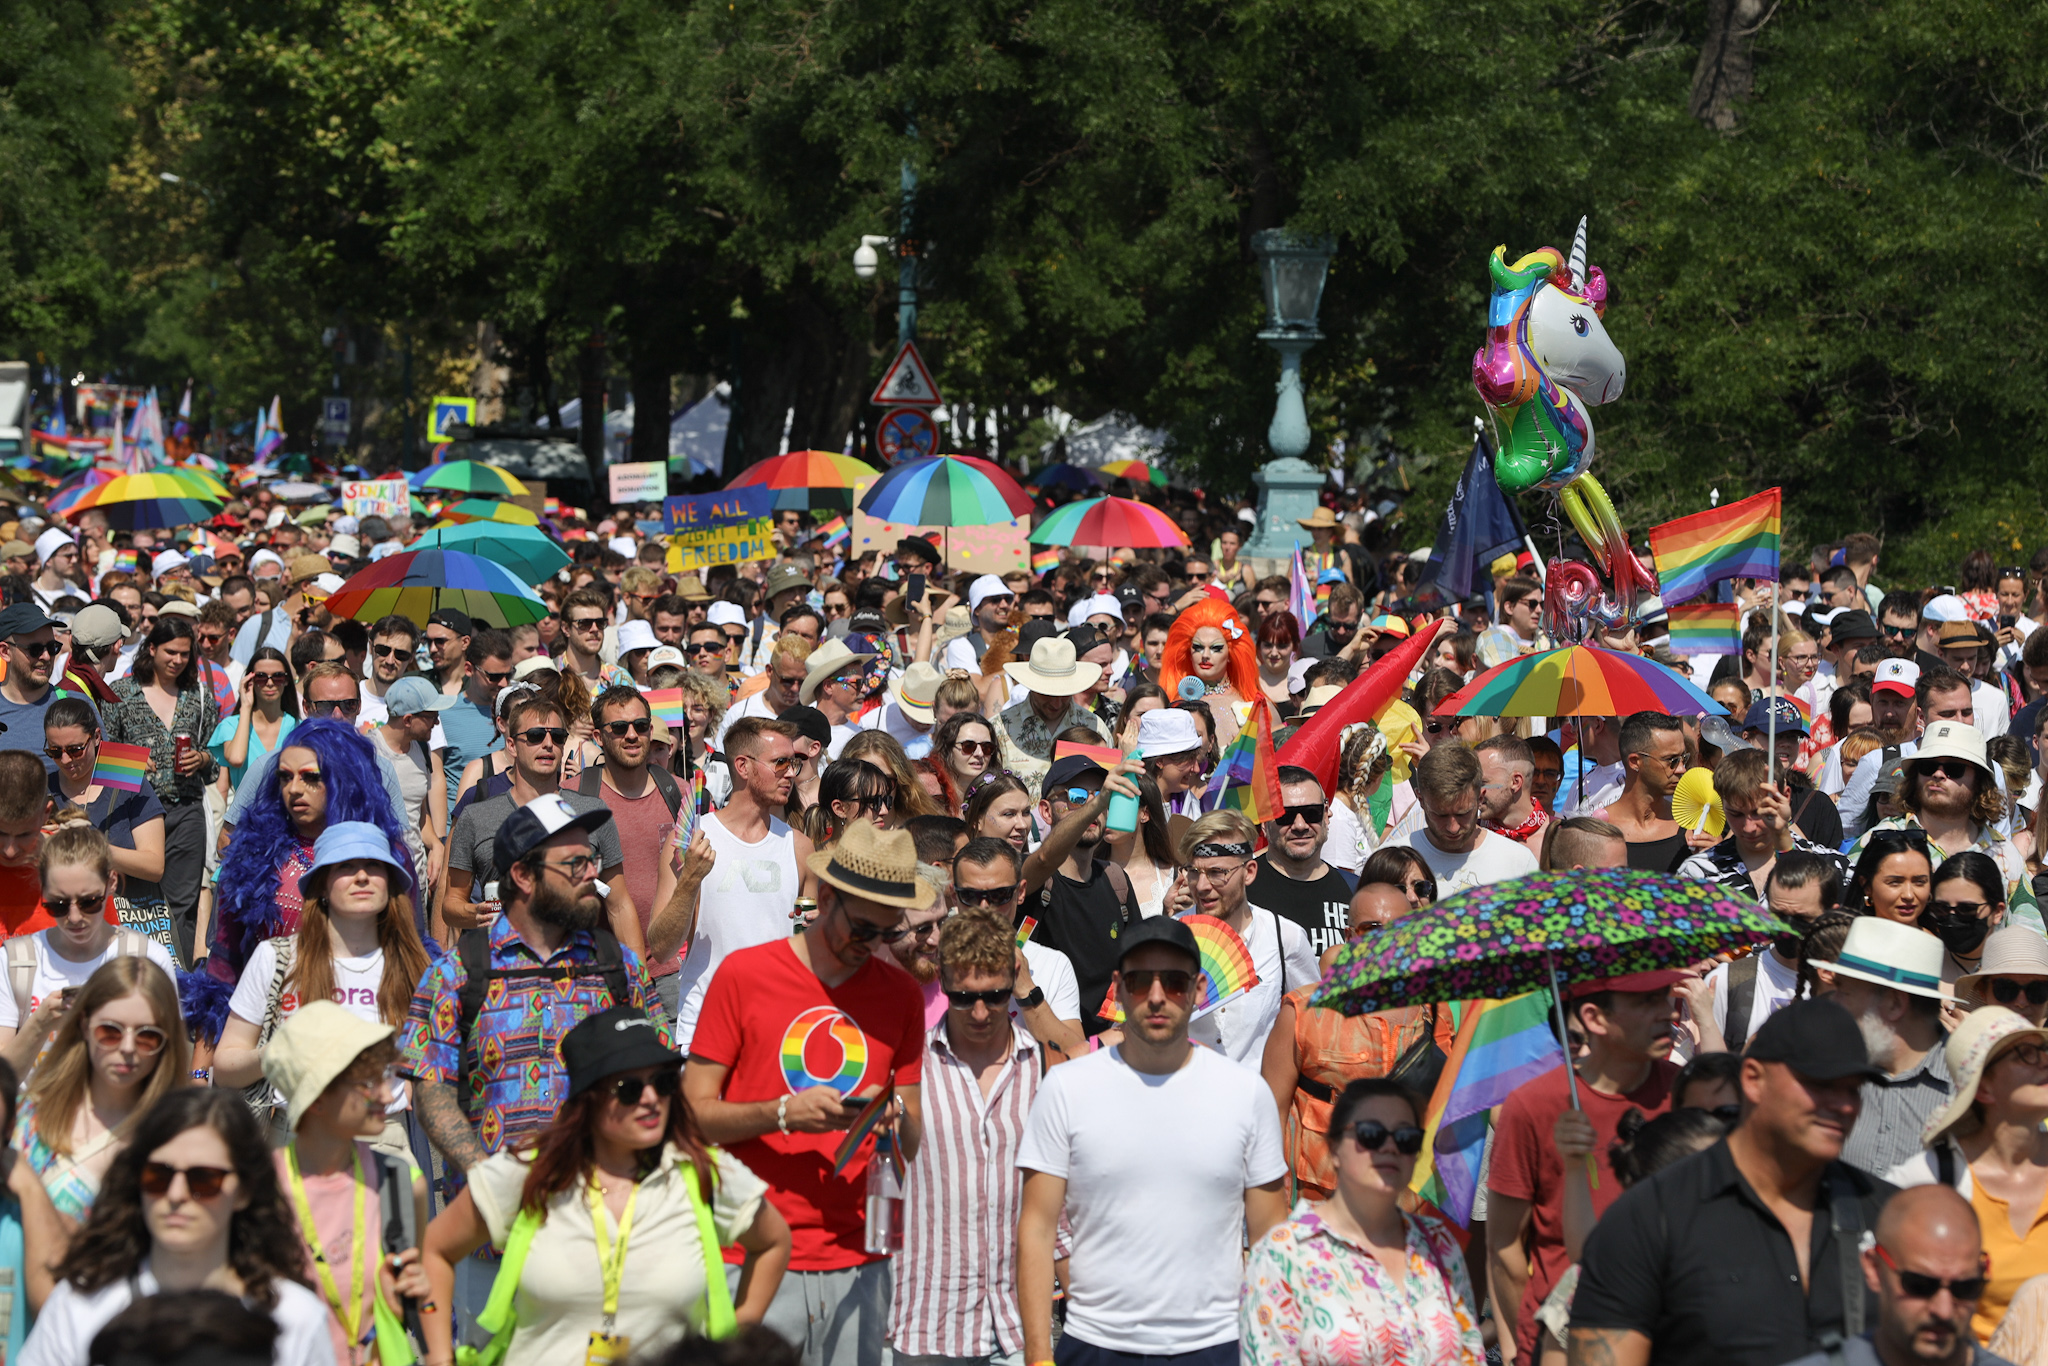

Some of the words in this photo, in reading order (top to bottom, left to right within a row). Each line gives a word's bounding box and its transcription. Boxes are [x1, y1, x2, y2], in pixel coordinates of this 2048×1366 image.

[671, 502, 698, 525] WE
[709, 499, 748, 519] ALL
[674, 523, 726, 544] FIGHT
[736, 515, 769, 537] FOR
[681, 538, 765, 567] FREEDOM
[117, 905, 170, 923] RAUNER
